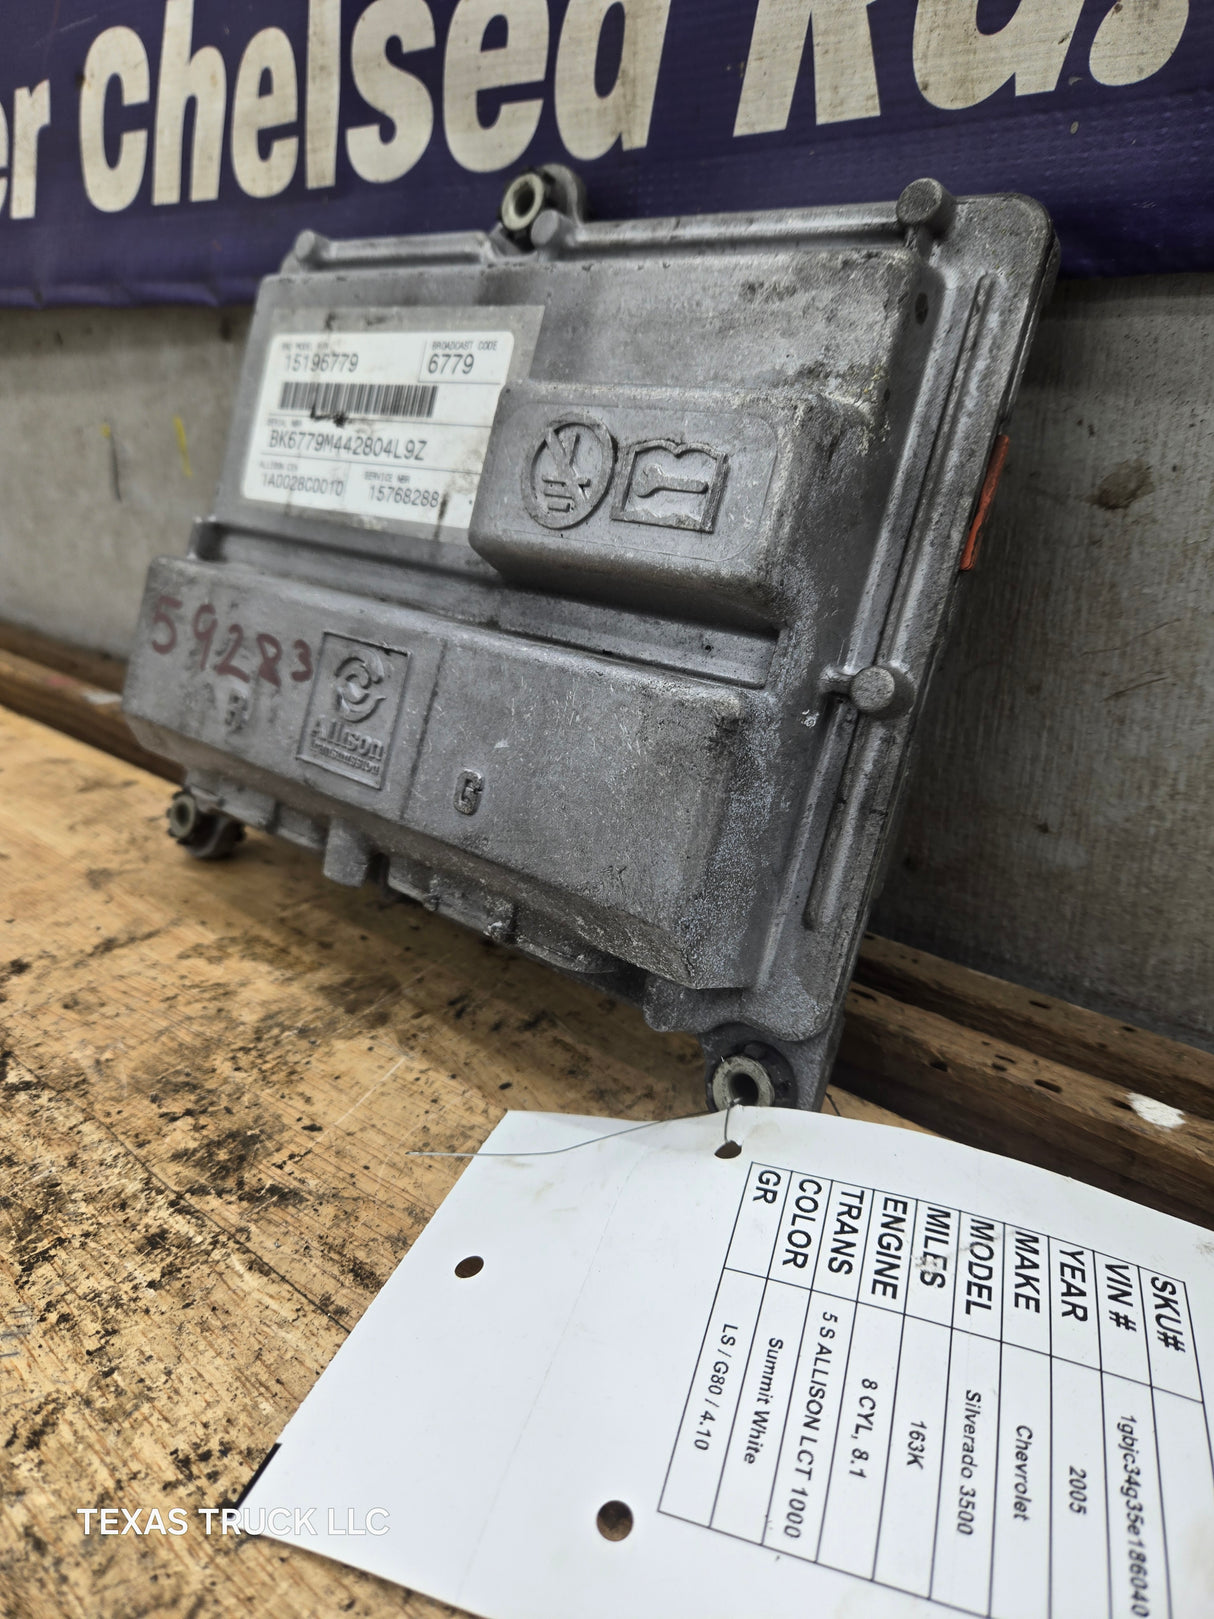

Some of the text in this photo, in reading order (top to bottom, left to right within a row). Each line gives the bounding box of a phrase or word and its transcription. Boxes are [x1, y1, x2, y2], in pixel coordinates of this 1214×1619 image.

[0, 79, 51, 219] r
[284, 352, 359, 373] 15196779
[427, 353, 475, 375] 6779
[478, 340, 499, 351] CODE
[369, 484, 440, 508] 15768288
[752, 1169, 782, 1205] GR
[781, 1178, 823, 1270] COLOR
[827, 1189, 866, 1277] TRANS
[870, 1196, 909, 1301] ENGINE
[919, 1206, 952, 1289] MILES
[964, 1217, 998, 1316] MODEL
[1013, 1230, 1041, 1314] MAKE
[1058, 1249, 1089, 1323] YEAR
[1104, 1263, 1138, 1333] VIN #
[720, 1323, 739, 1347] LS
[1150, 1276, 1187, 1354] SKU#
[707, 1360, 730, 1396] G80
[743, 1337, 785, 1466] Summit White
[802, 1341, 833, 1432] ALLISON
[693, 1408, 717, 1451] 4.10
[794, 1434, 818, 1482] LCT
[848, 1377, 879, 1480] 8 CYL, 8.1
[905, 1420, 928, 1471] 163K
[956, 1389, 982, 1536] Silverado 3500
[1012, 1424, 1034, 1523] Chevrolet
[1068, 1465, 1088, 1517] 2005
[783, 1487, 809, 1539] 1000
